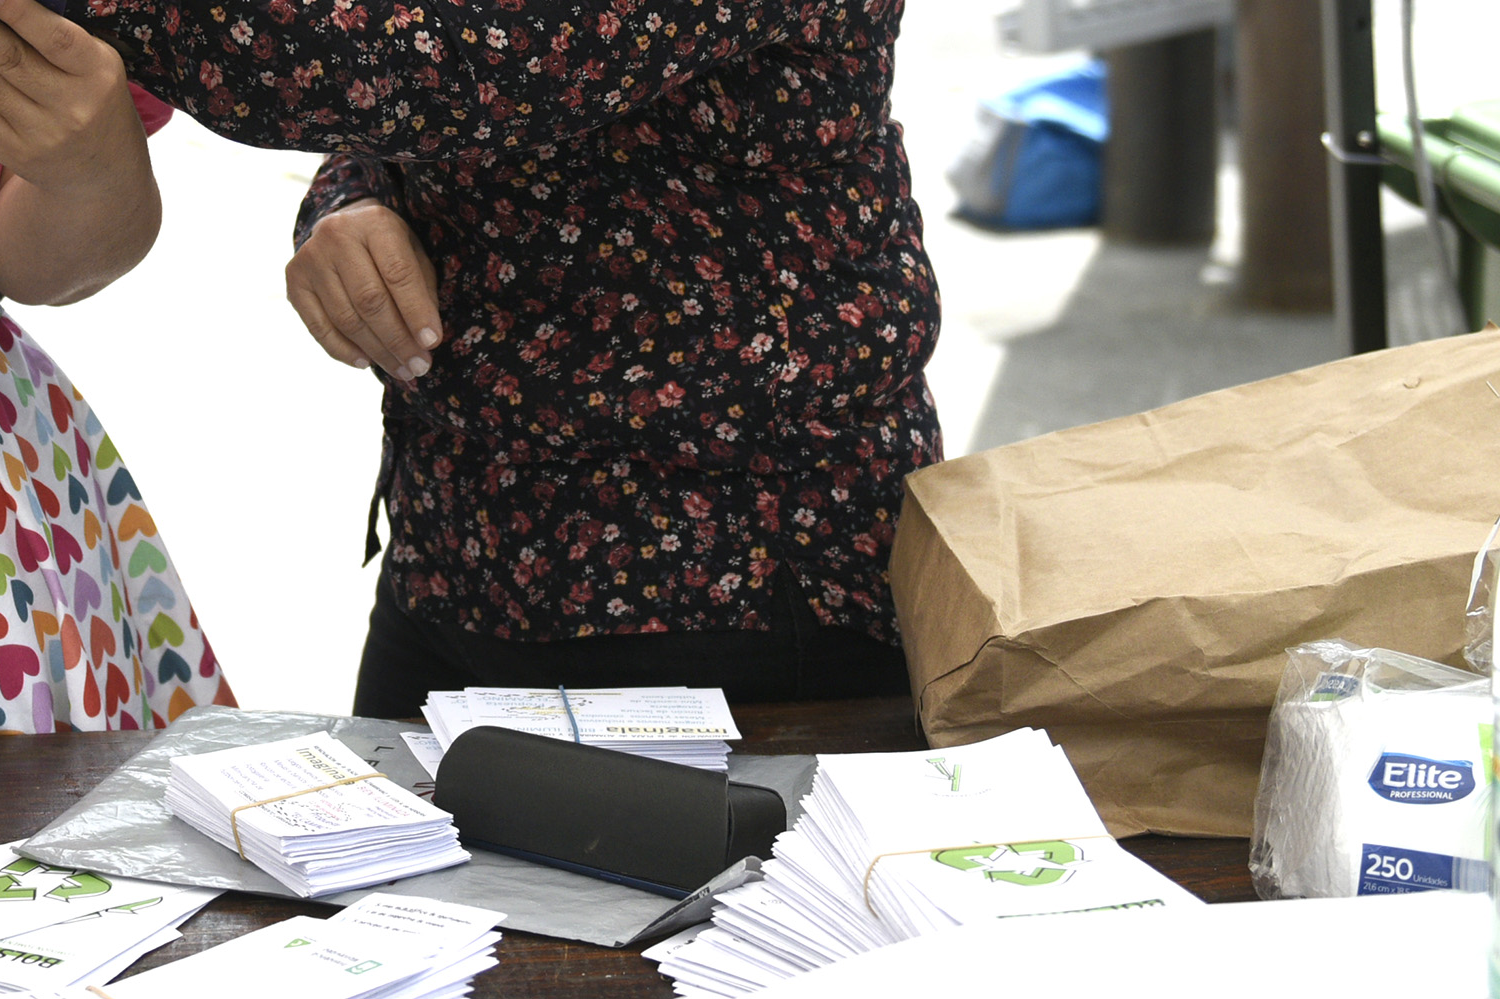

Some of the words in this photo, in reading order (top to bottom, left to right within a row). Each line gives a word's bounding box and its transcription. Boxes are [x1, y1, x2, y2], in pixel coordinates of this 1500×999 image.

[1383, 762, 1462, 789] Elite
[1390, 790, 1453, 800] PROFESSIONAL
[1366, 853, 1413, 880] 250
[1413, 874, 1448, 887] Unidades
